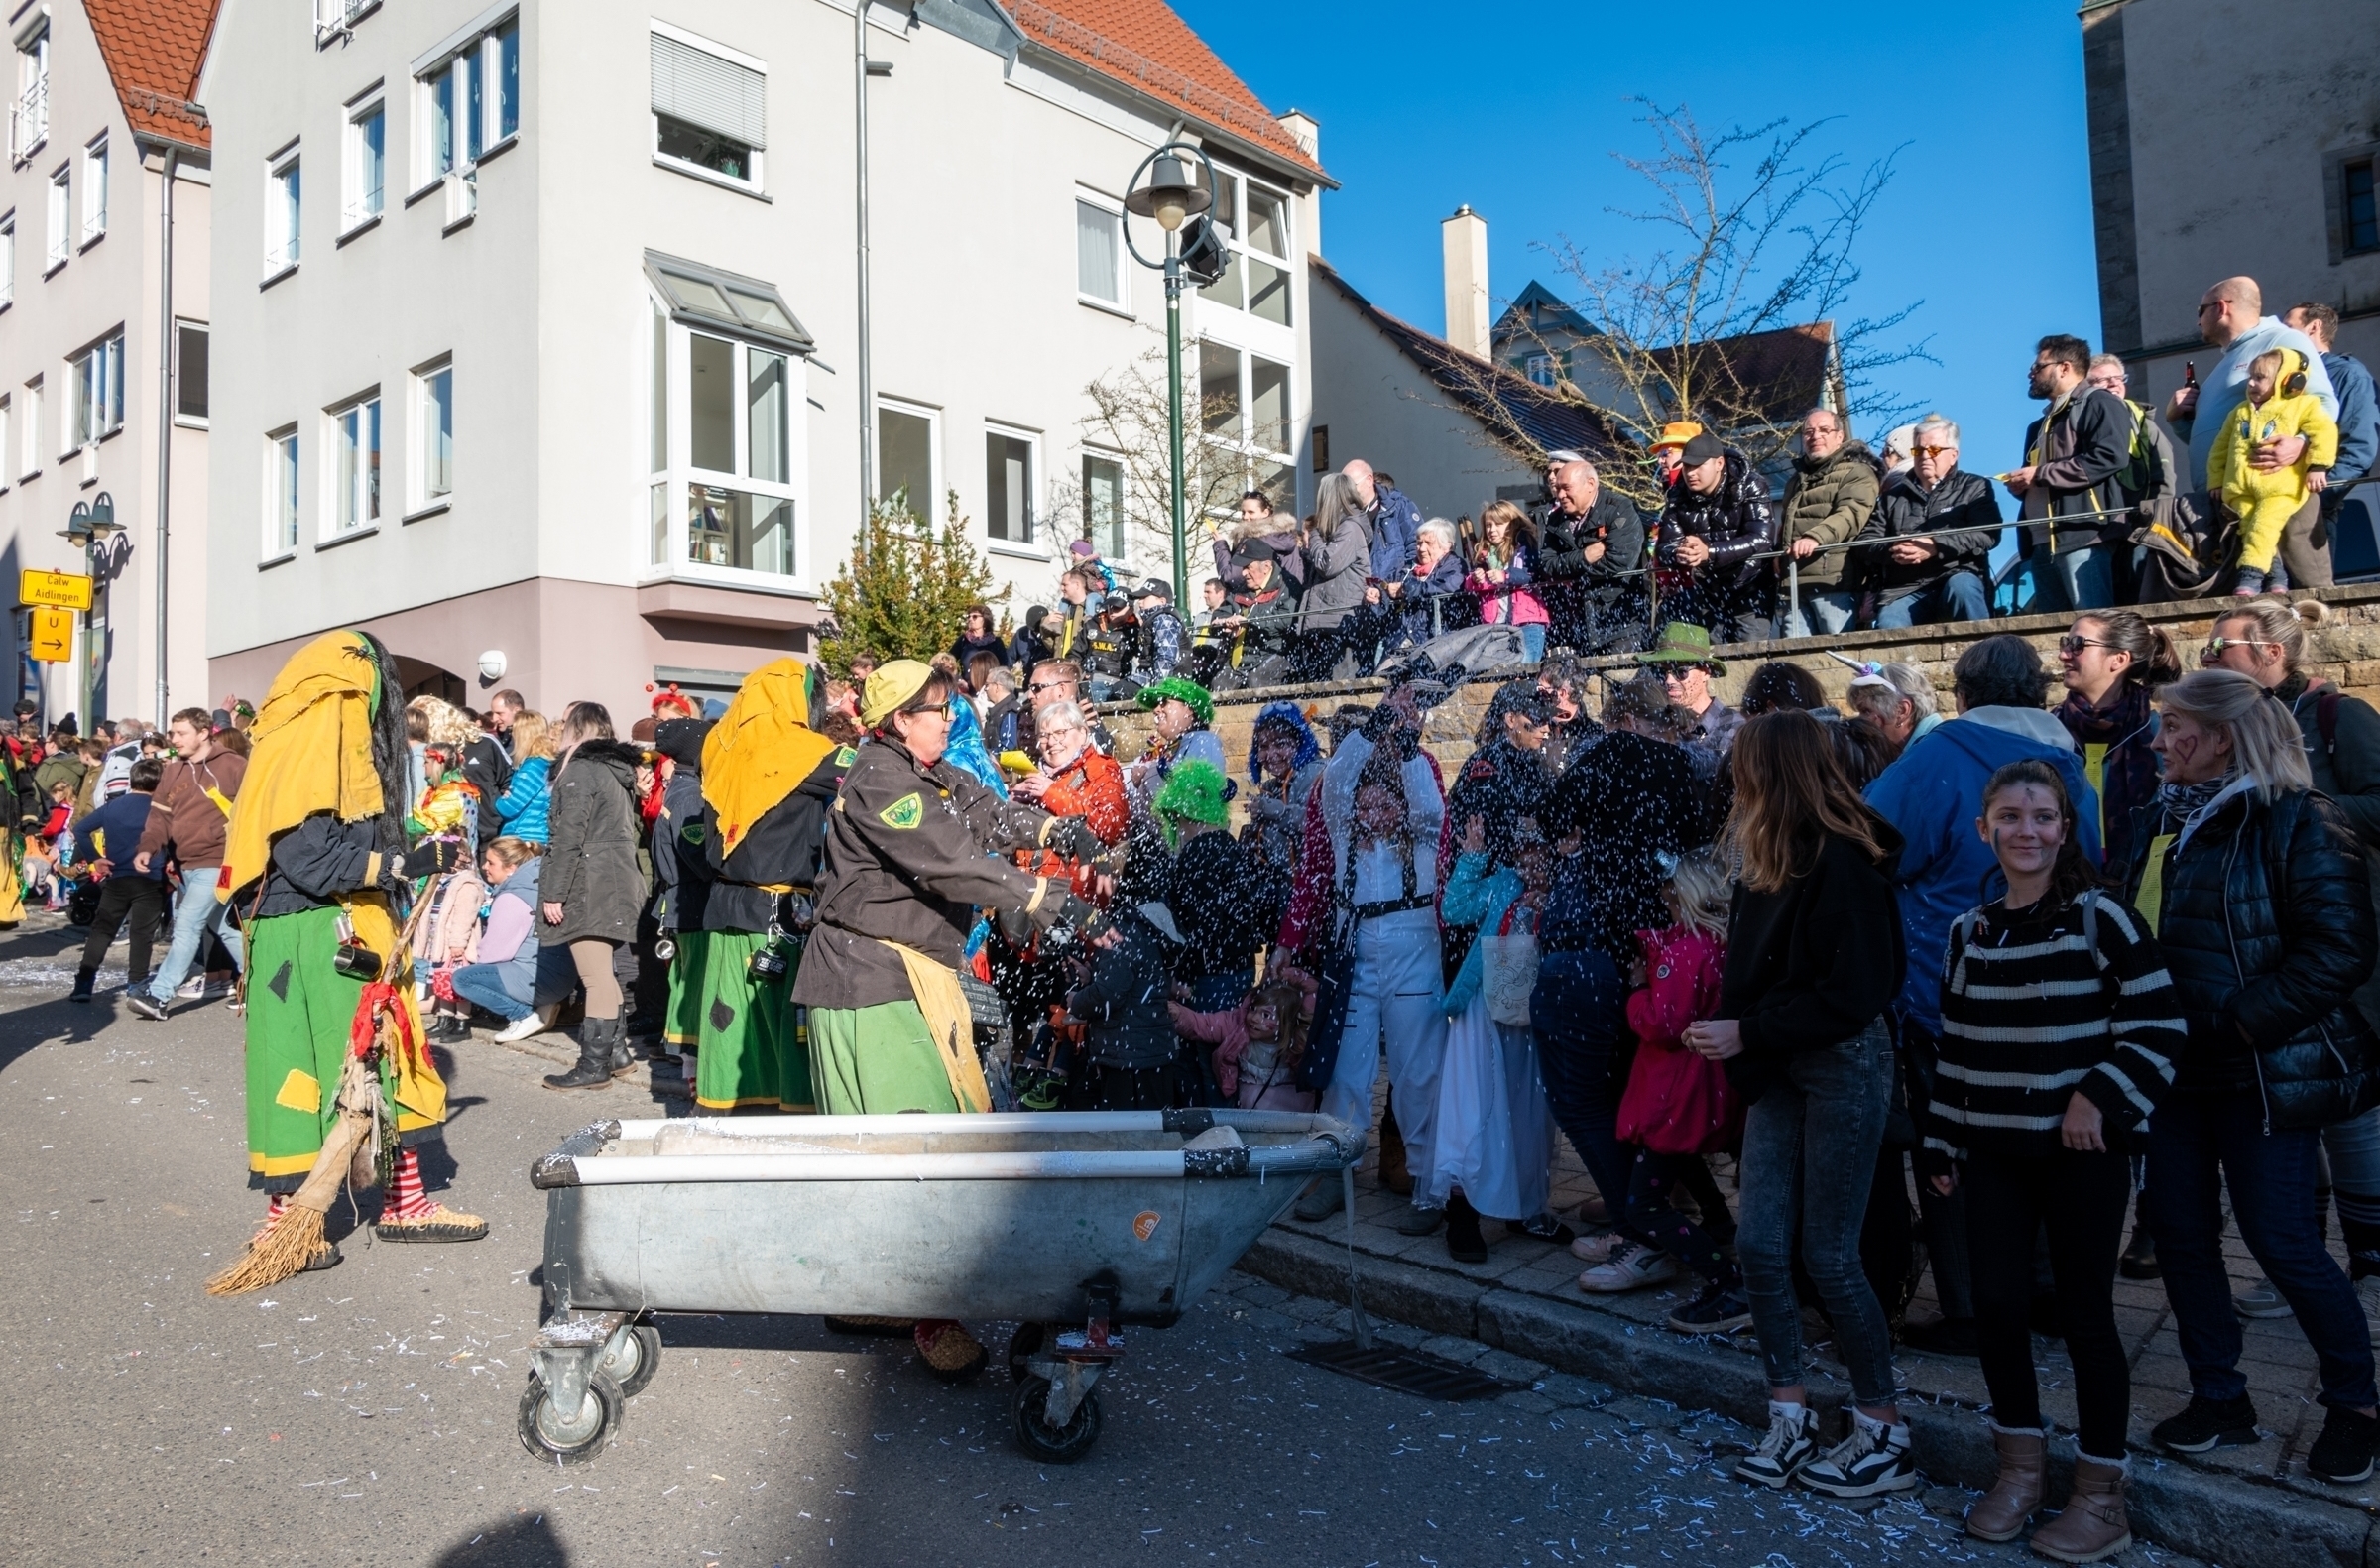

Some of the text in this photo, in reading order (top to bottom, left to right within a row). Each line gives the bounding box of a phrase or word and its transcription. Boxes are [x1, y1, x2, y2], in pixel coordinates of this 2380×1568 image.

[47, 575, 70, 587] Calw
[35, 589, 80, 603] Aidlingen
[49, 617, 59, 628] U
